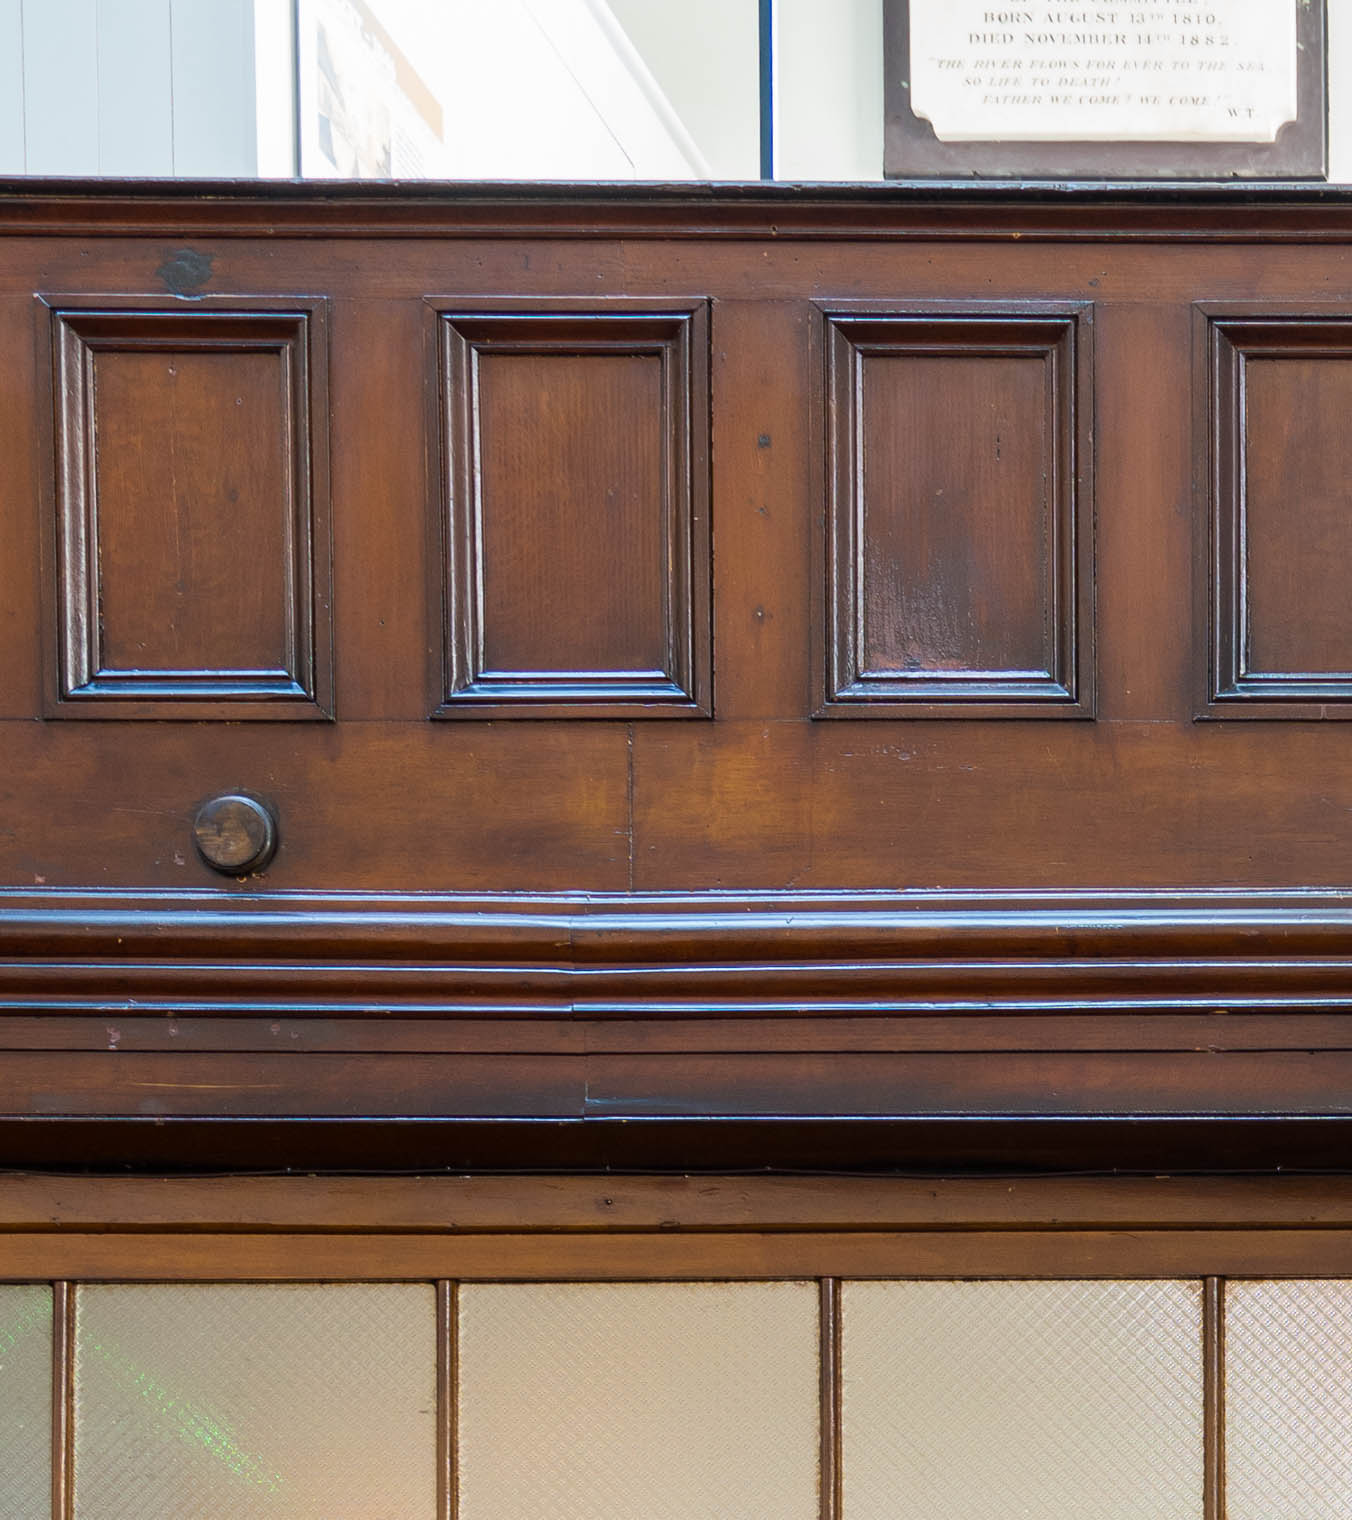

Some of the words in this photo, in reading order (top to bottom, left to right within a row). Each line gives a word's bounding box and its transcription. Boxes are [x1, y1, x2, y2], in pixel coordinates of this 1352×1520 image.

[983, 12, 1033, 24] BORN
[1043, 12, 1119, 24] AUGUST
[968, 33, 1014, 45] DIED
[1024, 33, 1127, 45] NOVEMBER
